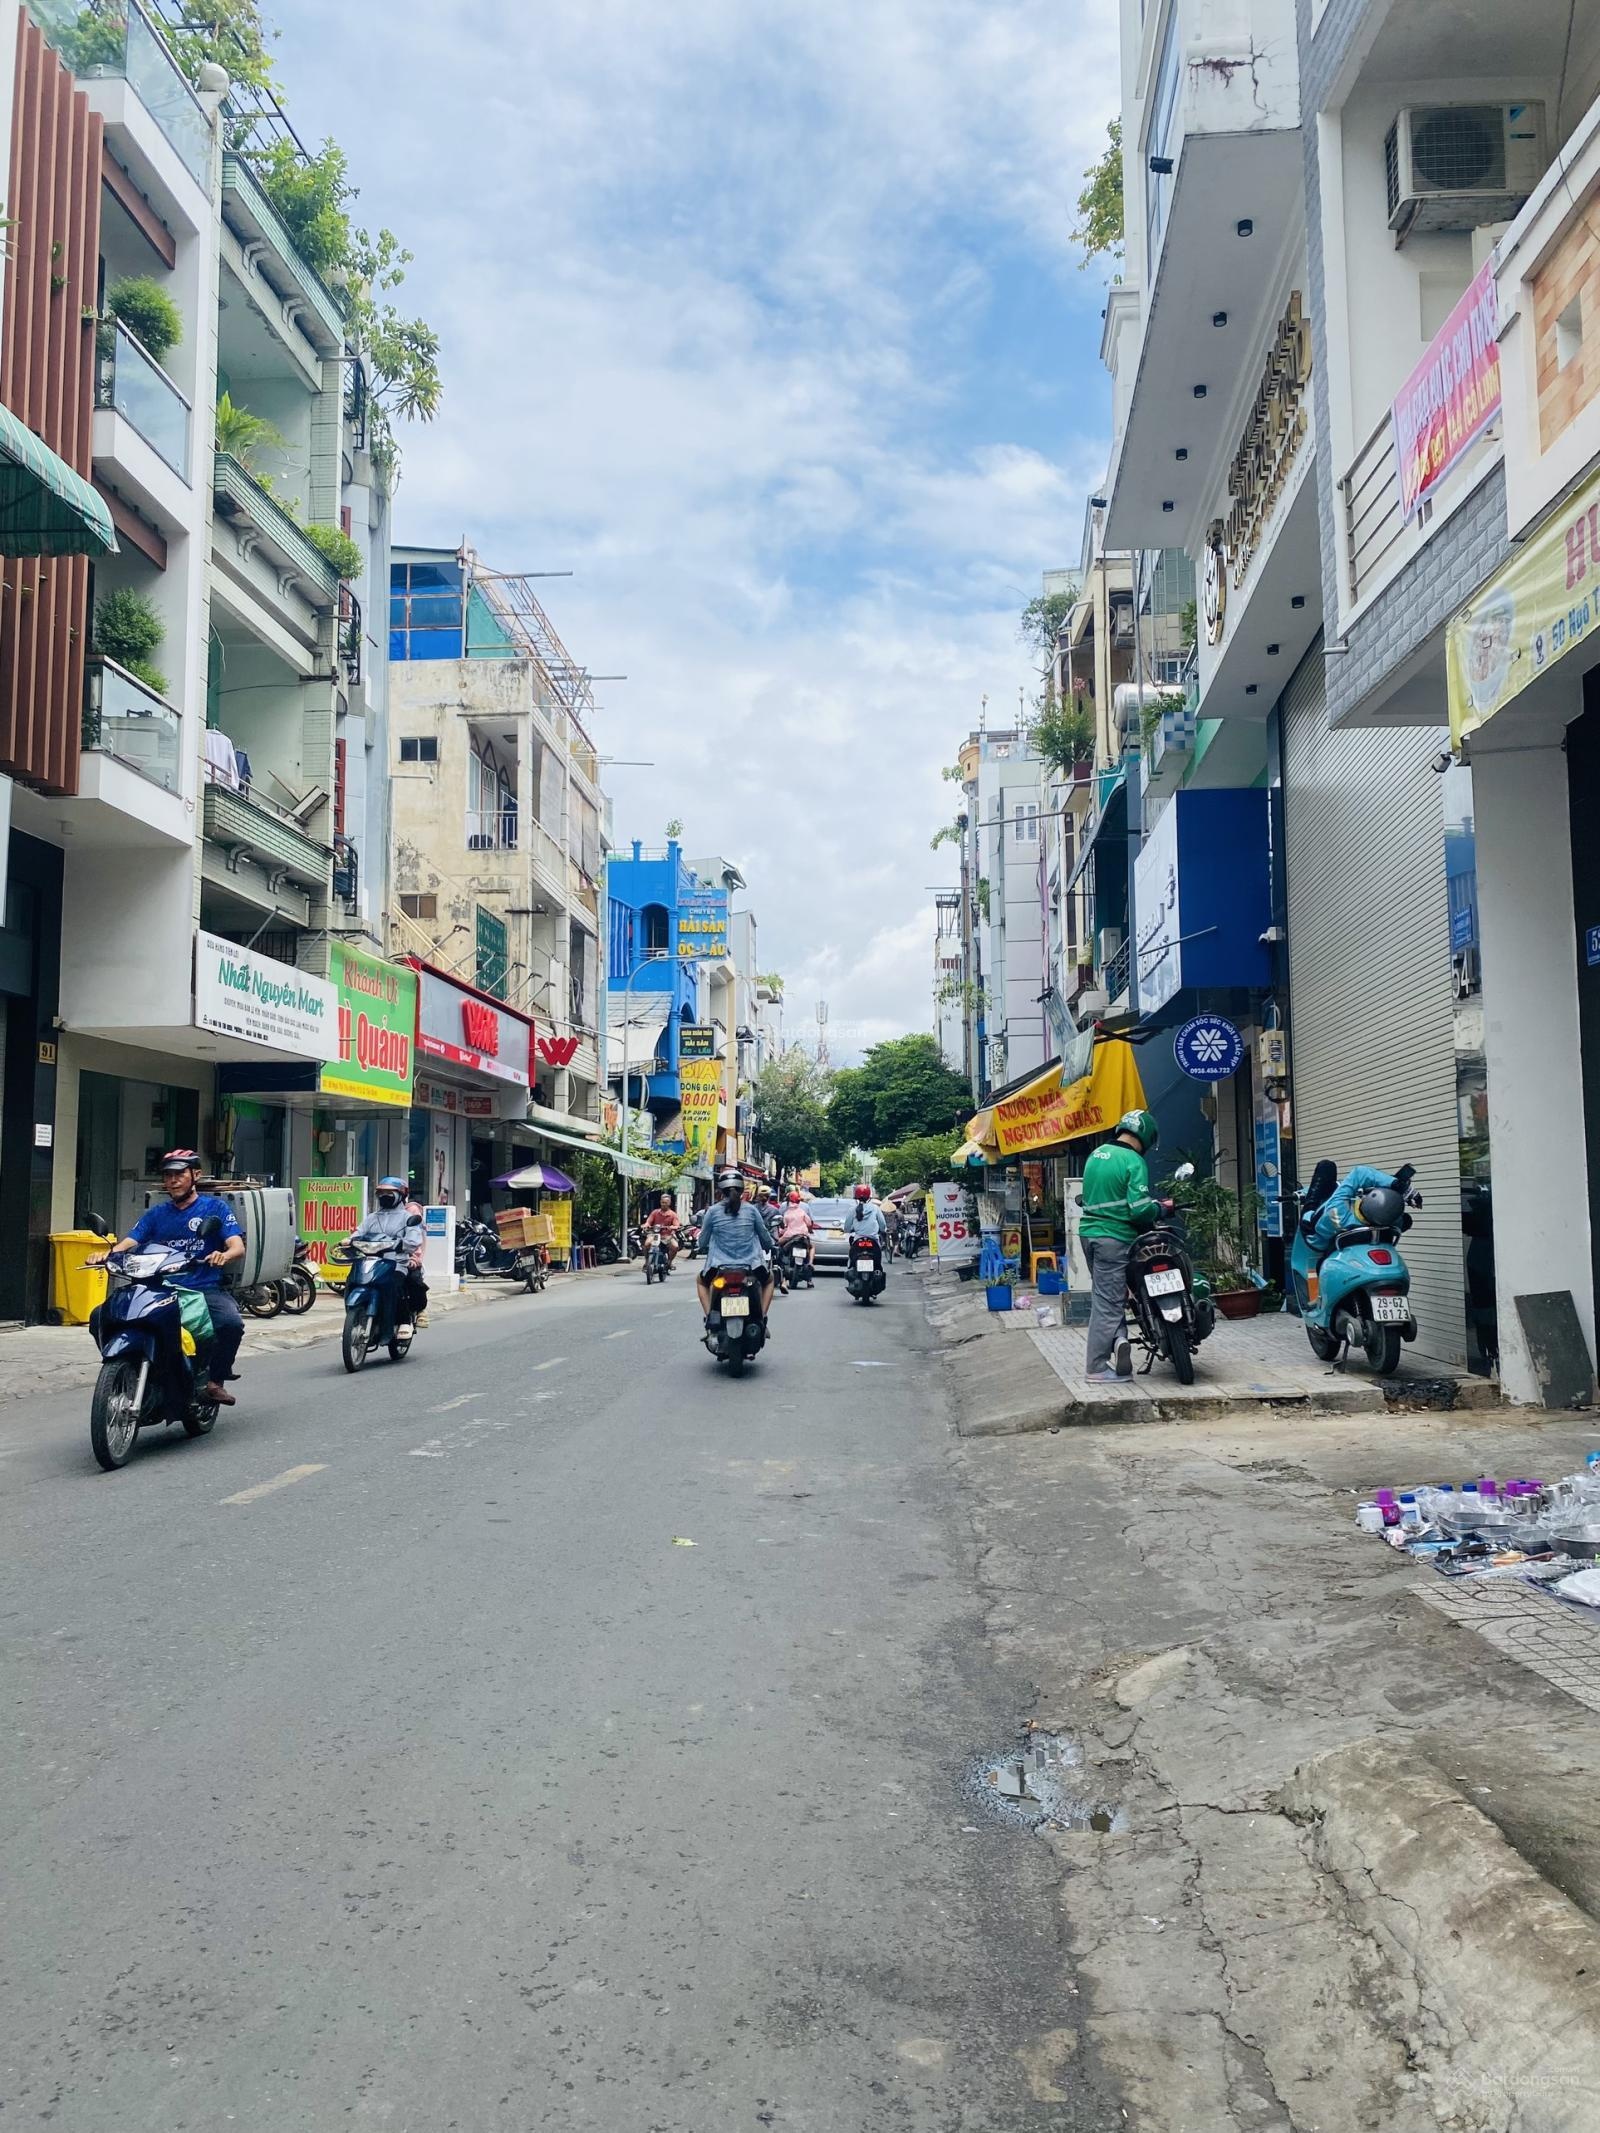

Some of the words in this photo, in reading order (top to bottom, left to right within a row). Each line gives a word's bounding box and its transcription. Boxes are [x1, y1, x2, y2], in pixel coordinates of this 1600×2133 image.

[218, 957, 251, 993] Nhất
[252, 970, 297, 1009] Nguyên
[298, 986, 325, 1018] Mart
[41, 1044, 53, 1058] 91
[357, 1014, 410, 1081] Quảng
[680, 1062, 718, 1079] BIA
[1002, 1115, 1064, 1147] NGUYÊN
[1064, 1100, 1104, 1131] CHẤT
[1093, 1150, 1111, 1160] Grab
[1377, 1297, 1404, 1308] 29-G2
